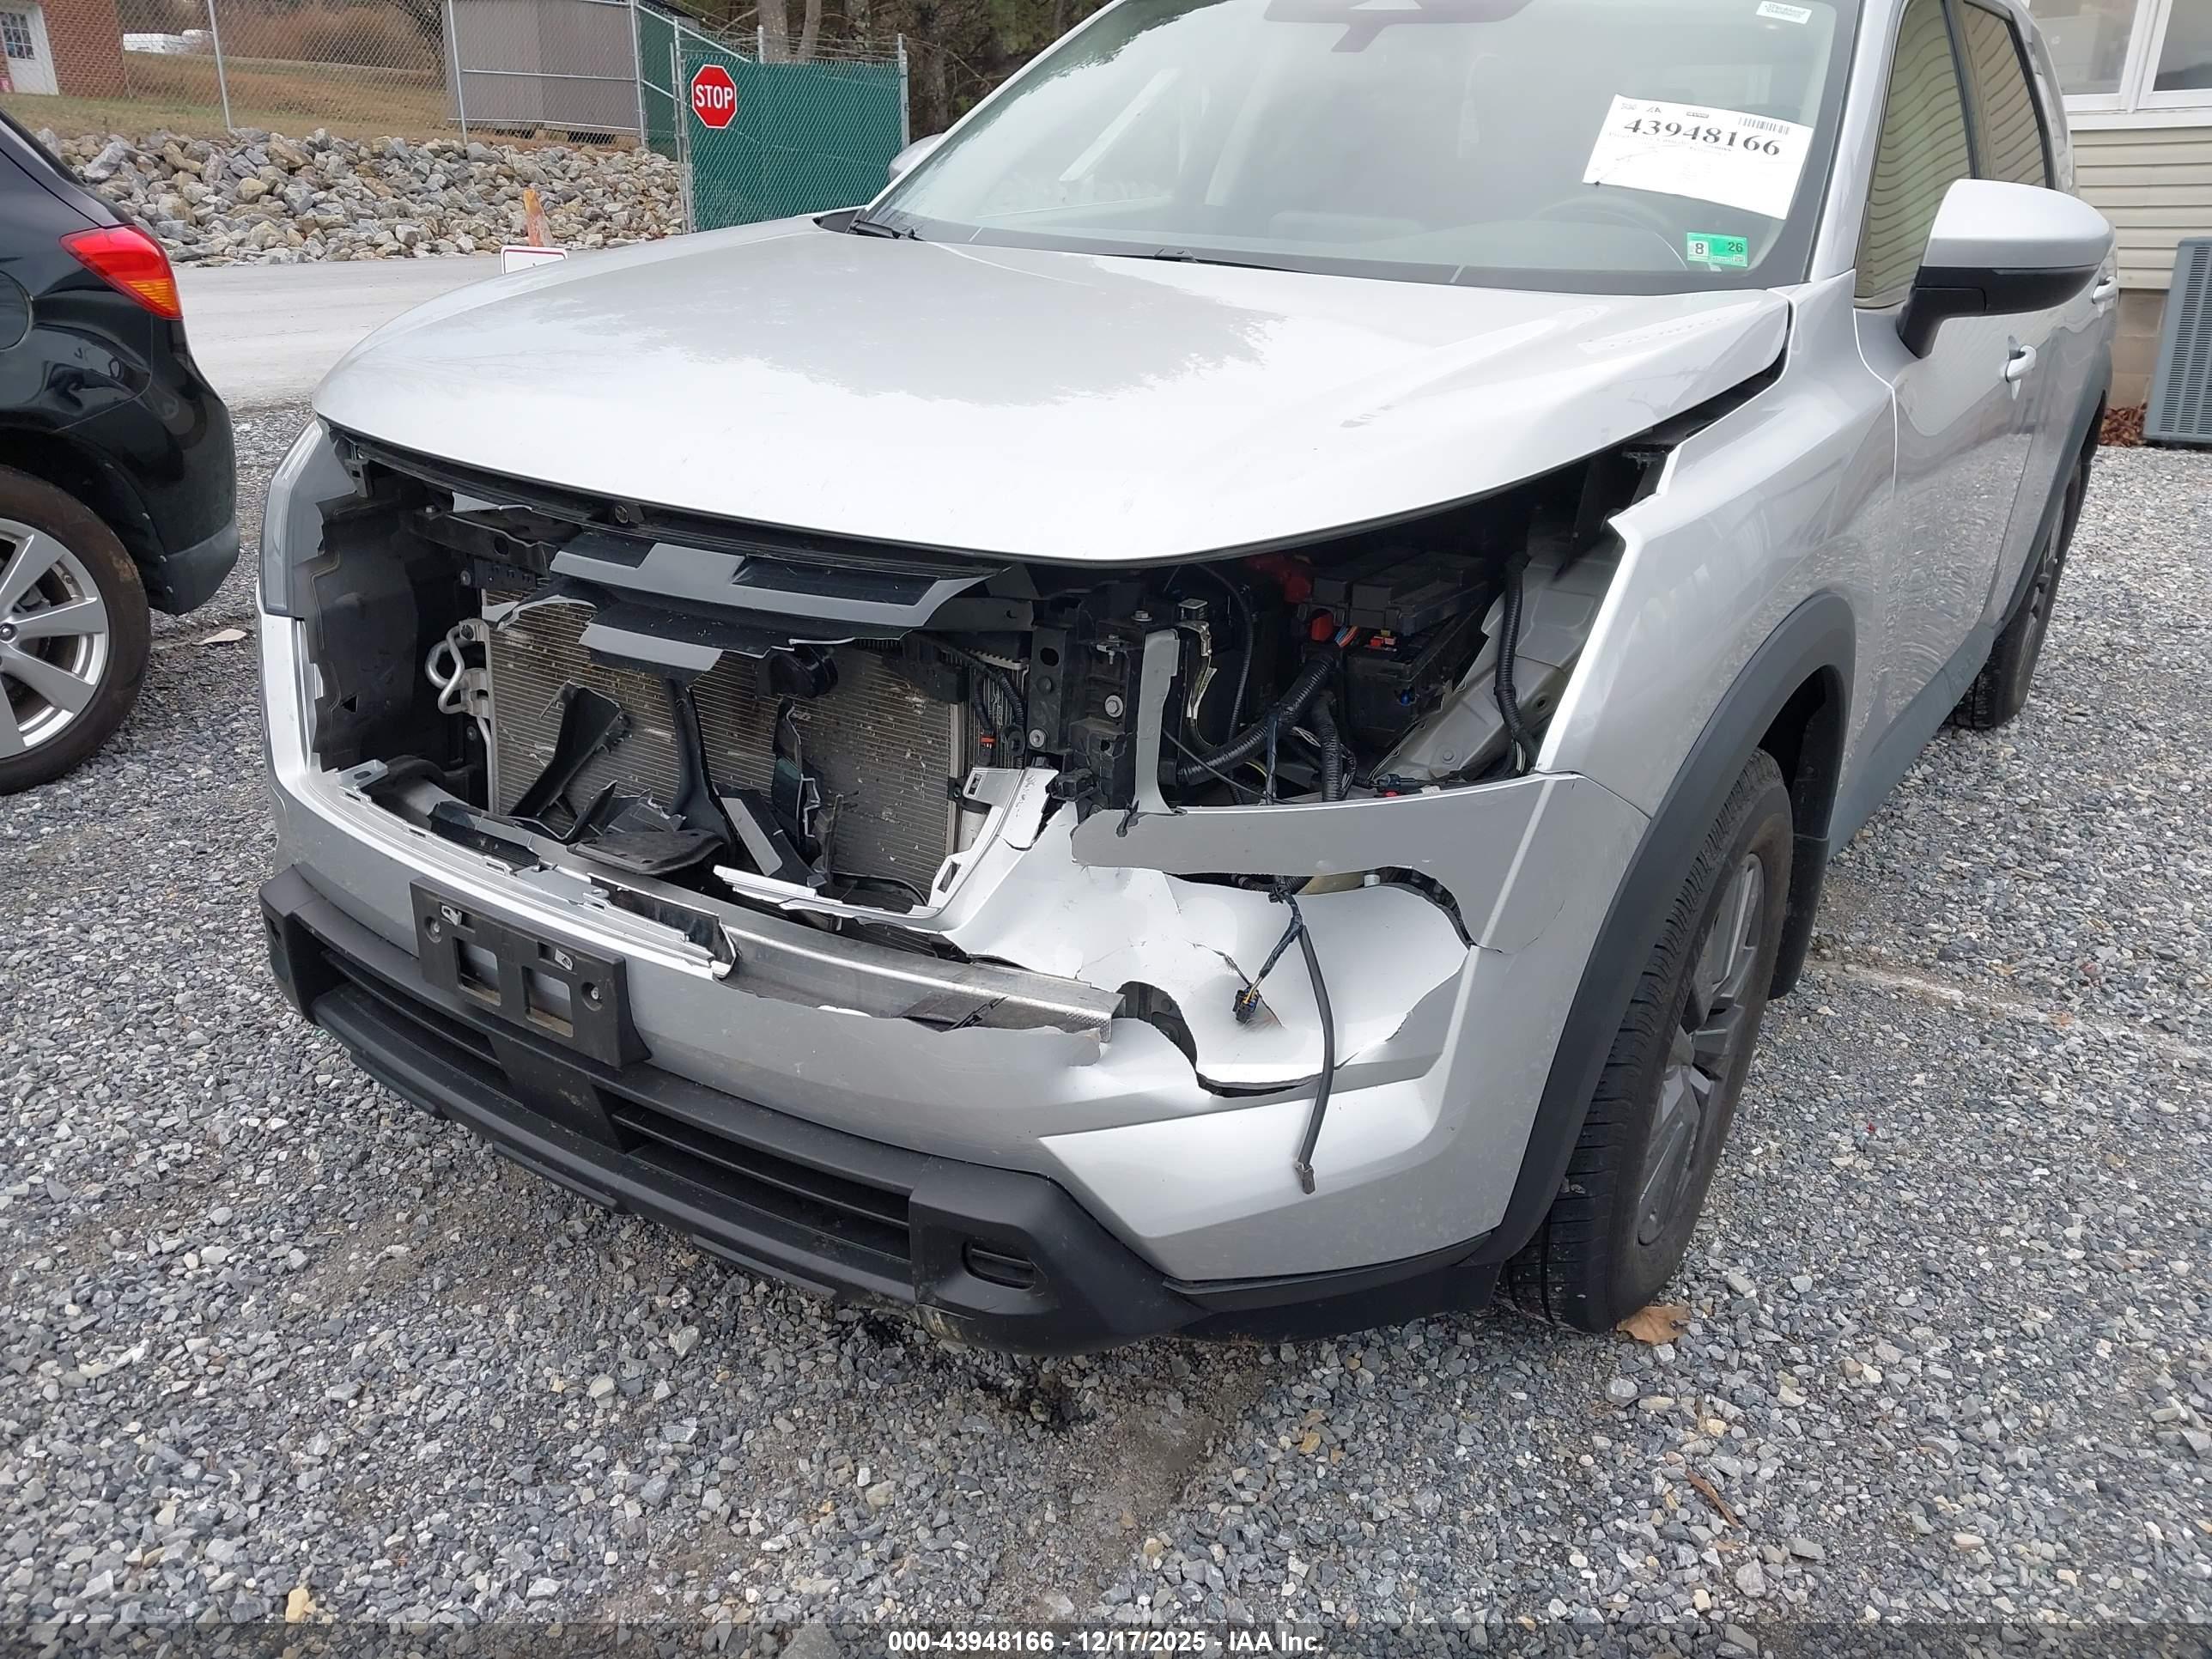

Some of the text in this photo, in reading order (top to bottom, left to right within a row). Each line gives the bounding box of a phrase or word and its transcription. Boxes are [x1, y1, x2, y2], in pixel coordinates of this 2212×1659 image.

[696, 84, 733, 109] STOP
[1624, 118, 1783, 156] 43948166
[1694, 241, 1744, 255] 8 26
